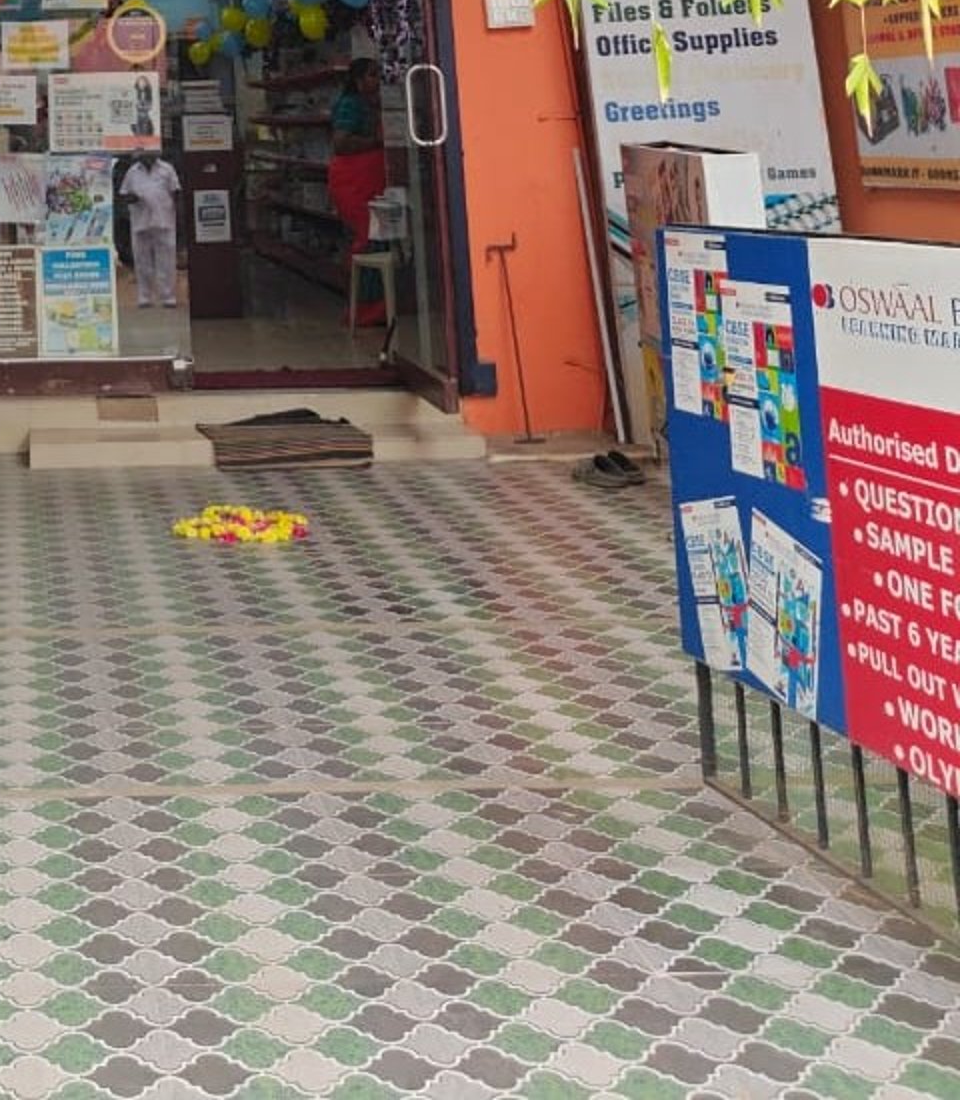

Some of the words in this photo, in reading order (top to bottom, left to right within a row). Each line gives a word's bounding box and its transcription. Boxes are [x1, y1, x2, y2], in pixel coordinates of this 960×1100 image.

[593, 2, 652, 24] Files
[596, 35, 662, 57] Offic
[672, 27, 779, 55] Supplies
[604, 99, 721, 123] Greetings
[766, 165, 817, 180] Games
[829, 417, 938, 471] Authorised
[866, 522, 955, 576] SAMPLE
[887, 569, 934, 611] ONE
[854, 598, 902, 639] PAST
[907, 621, 921, 648] 6
[858, 642, 903, 681] PULL
[907, 664, 946, 701] OUT
